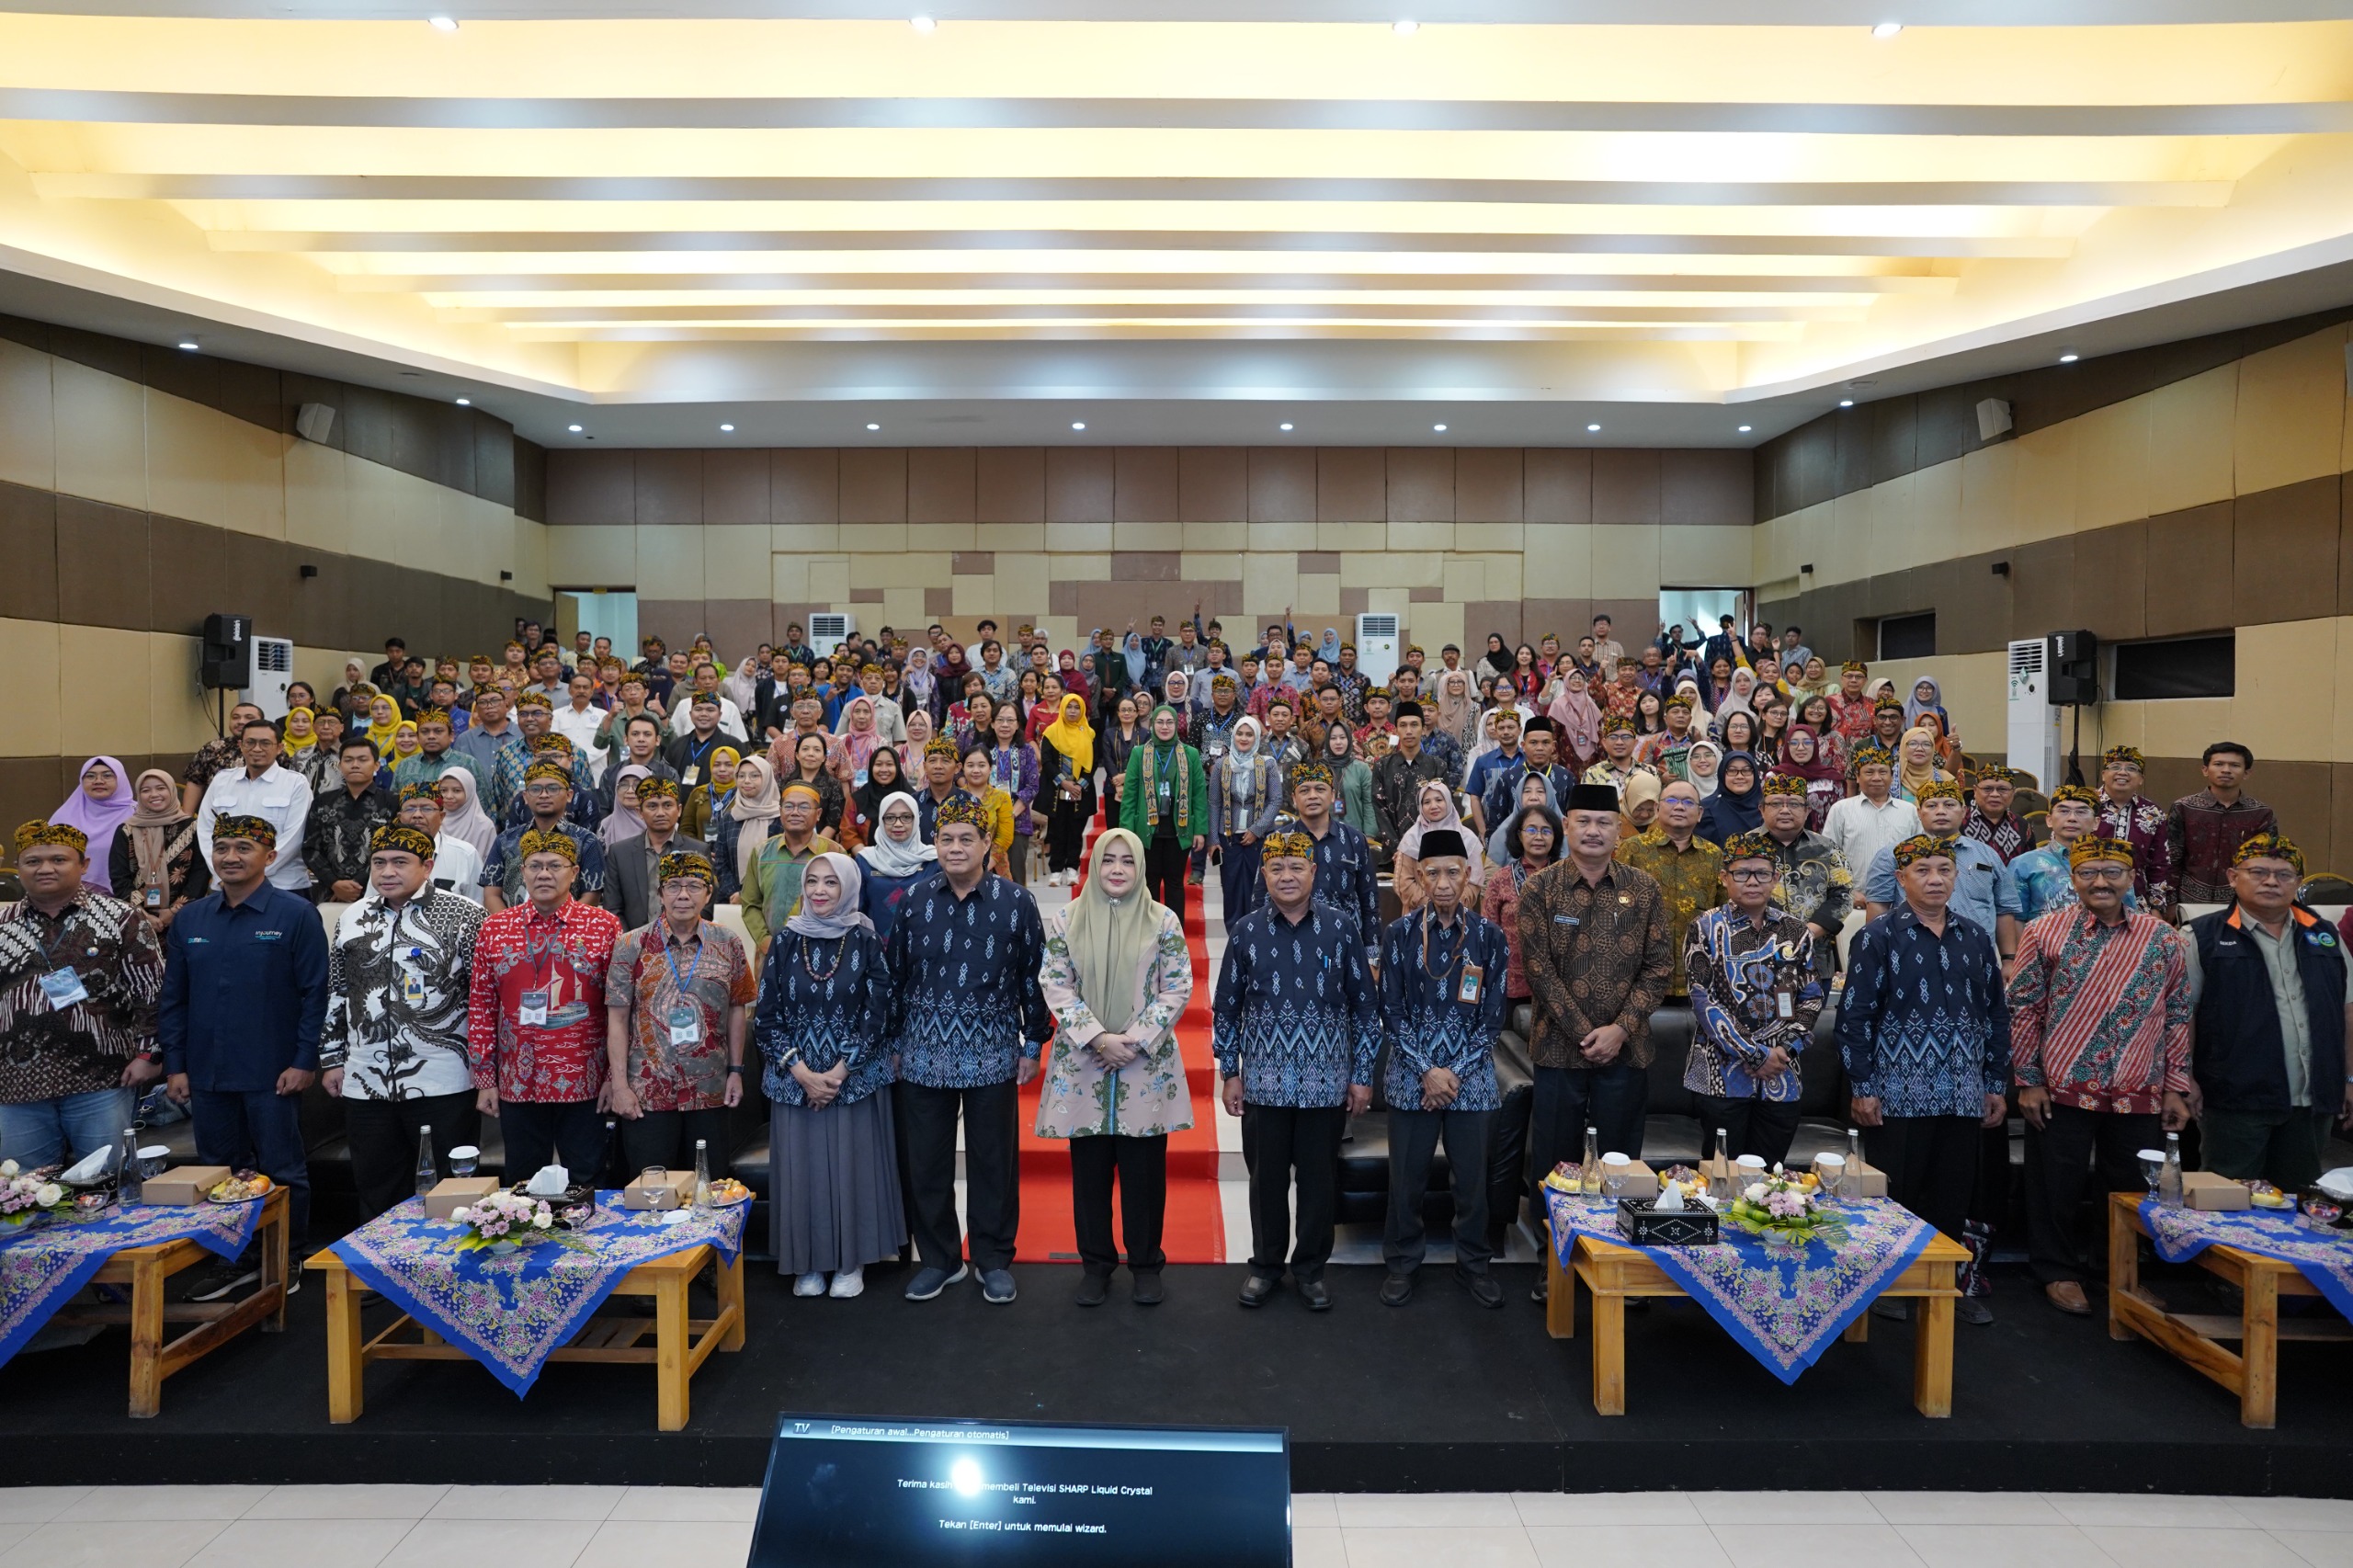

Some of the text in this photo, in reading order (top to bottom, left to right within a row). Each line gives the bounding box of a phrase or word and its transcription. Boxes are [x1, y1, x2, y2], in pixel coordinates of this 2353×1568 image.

[794, 1423, 810, 1433] TV
[831, 1426, 885, 1436] [Pengaturan
[967, 1430, 1009, 1440] otomatis]
[897, 1479, 927, 1489] Terima
[982, 1483, 1019, 1492] membeli
[1023, 1483, 1056, 1493] Televisi
[1059, 1484, 1089, 1494] SHARP
[1091, 1485, 1119, 1495] Liquid
[1120, 1486, 1153, 1496] Crystal
[1013, 1495, 1037, 1505] kami.
[938, 1519, 1107, 1533] Tekan [Enter] untuk memulai wizard.
